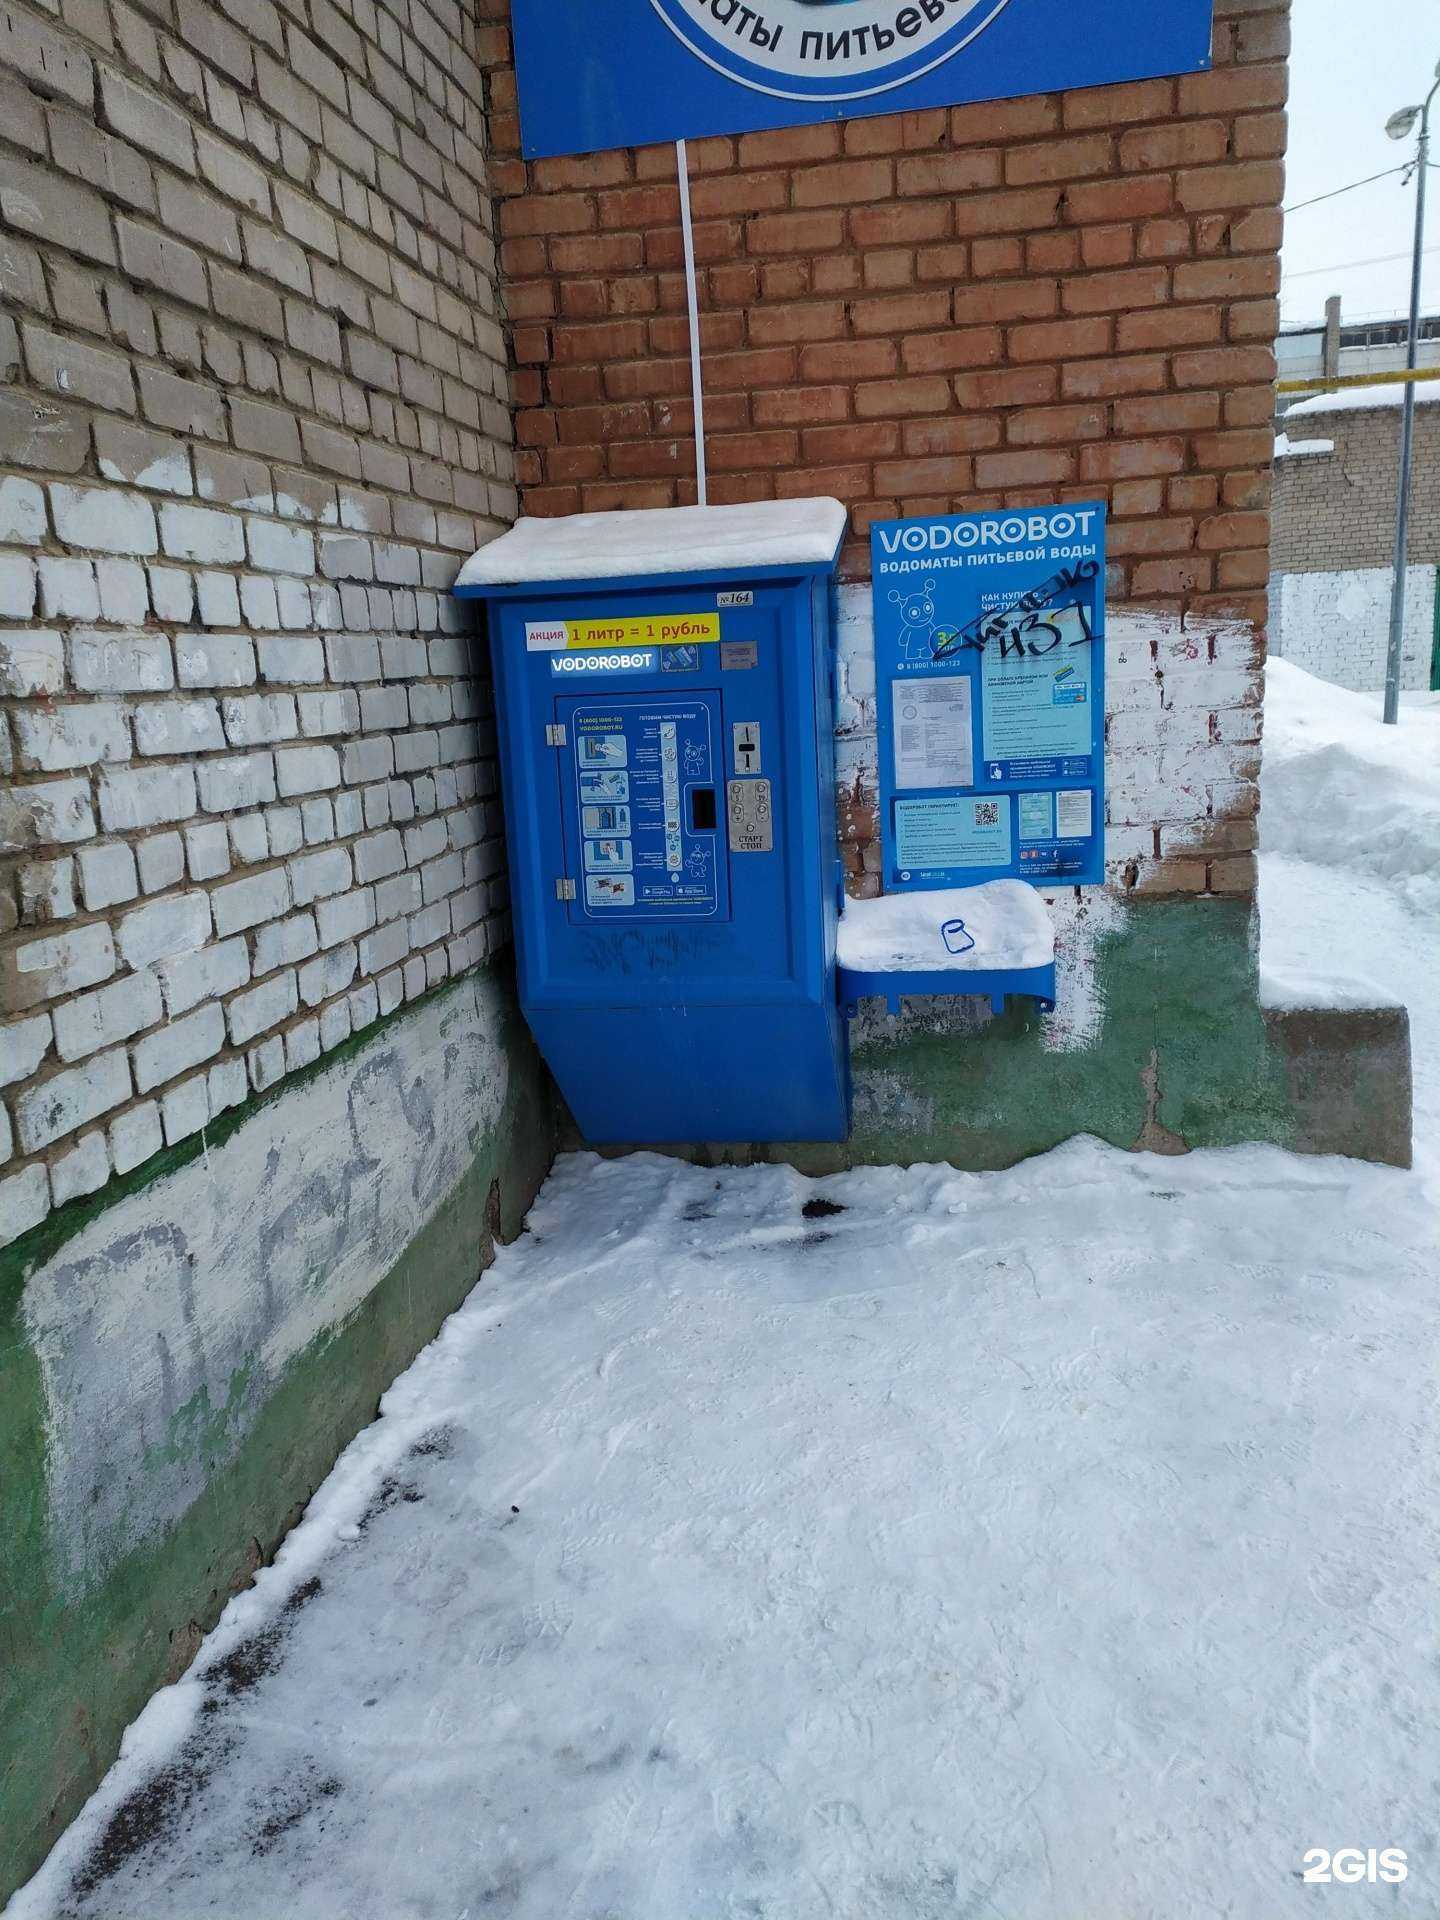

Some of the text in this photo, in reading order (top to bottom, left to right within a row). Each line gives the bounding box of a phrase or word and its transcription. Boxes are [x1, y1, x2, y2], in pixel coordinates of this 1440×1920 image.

[699, 0, 961, 60] аты питьев
[880, 511, 1096, 553] VODOROBOT
[880, 544, 1096, 574] ВОДОМАТЫ ПИТЬЕВОЙ ВОДЫ
[981, 594, 999, 602] КАК
[529, 630, 564, 641] АКЦИЯ
[572, 629, 580, 640] 1
[587, 628, 624, 642] литр
[647, 625, 655, 637] 1
[661, 622, 710, 639] рубль
[551, 654, 653, 672] VODOROBOT
[738, 835, 764, 843] СТАРТ
[740, 842, 762, 850] СТОП
